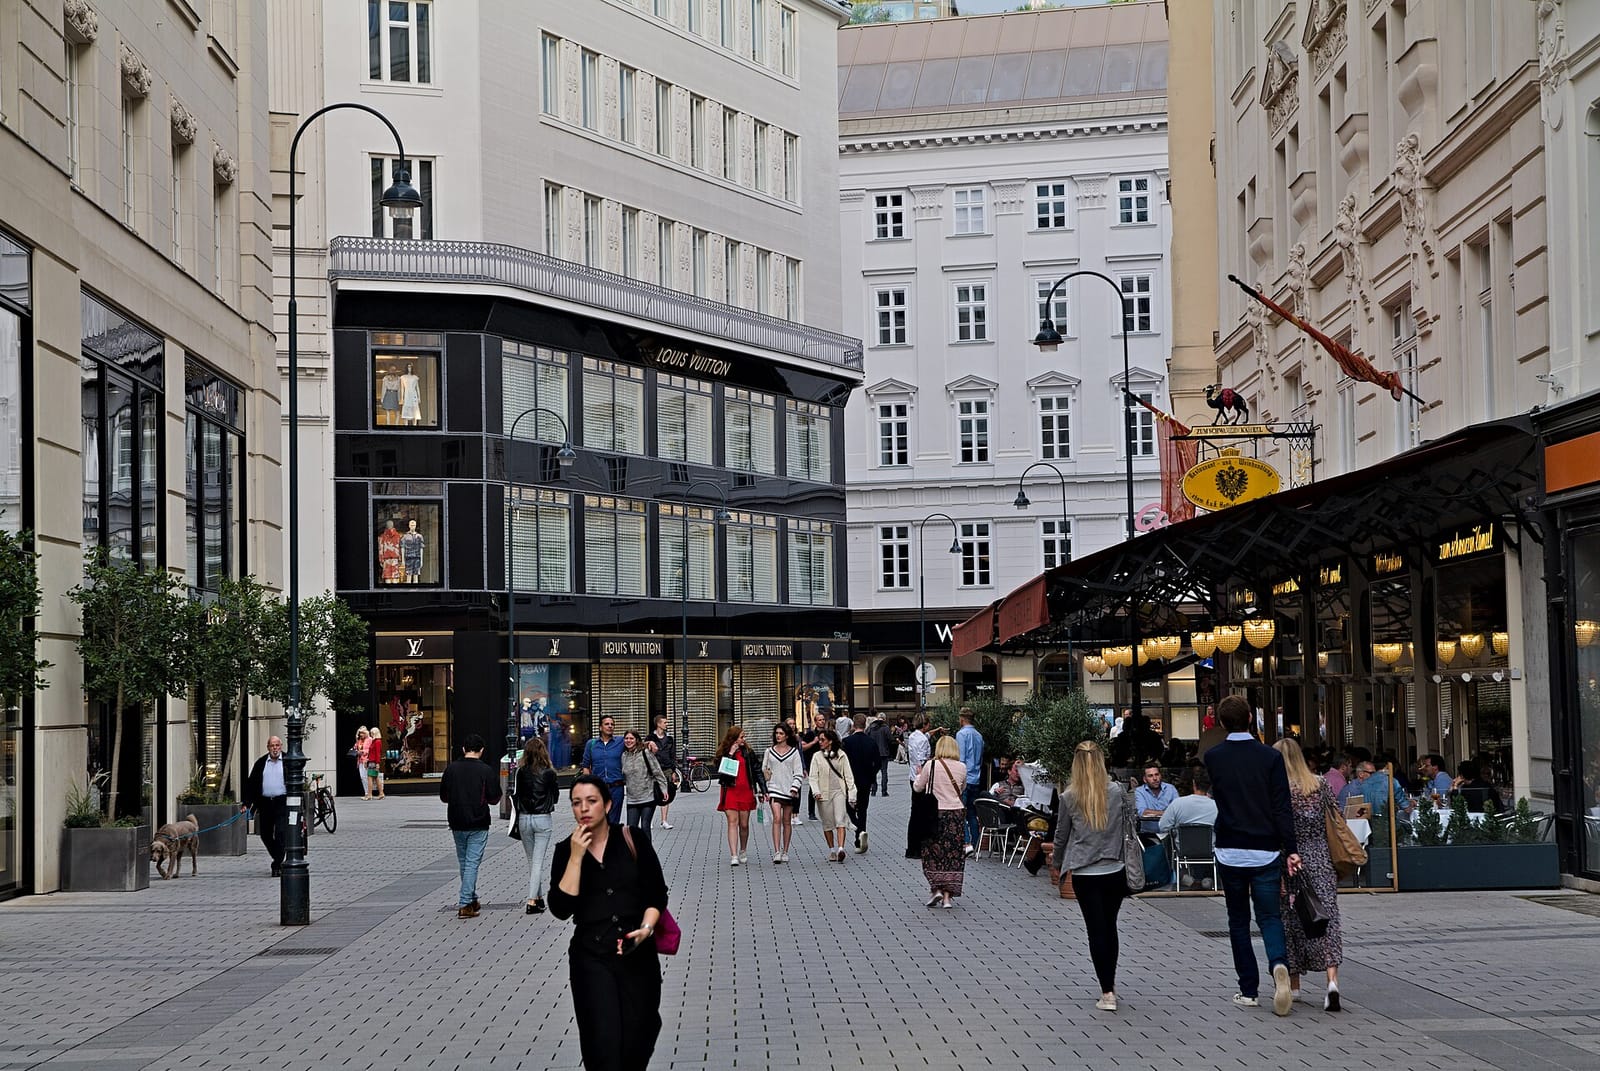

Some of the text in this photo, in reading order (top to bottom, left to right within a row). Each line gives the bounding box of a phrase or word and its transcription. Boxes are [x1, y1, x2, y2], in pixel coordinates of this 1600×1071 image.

[656, 347, 731, 376] LOUIS VUITTON
[603, 641, 662, 655] LOUIS VUITTON
[743, 643, 793, 656] LOUIS VUITTON
